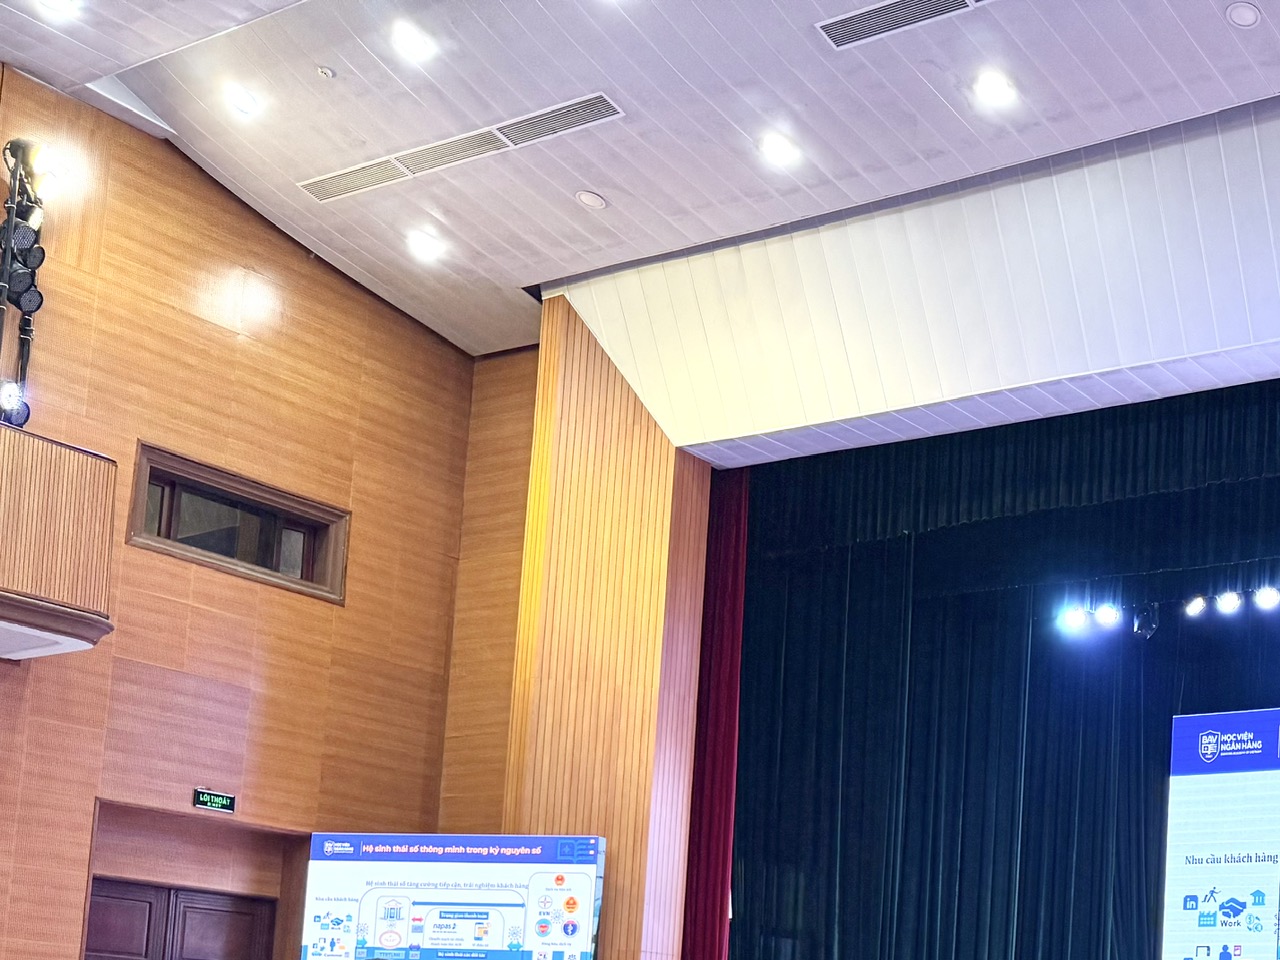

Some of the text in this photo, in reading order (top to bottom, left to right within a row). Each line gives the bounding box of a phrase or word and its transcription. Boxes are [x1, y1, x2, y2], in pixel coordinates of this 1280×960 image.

[1202, 735, 1217, 743] BAV
[1185, 852, 1278, 865] Nhu cầu khách hàng
